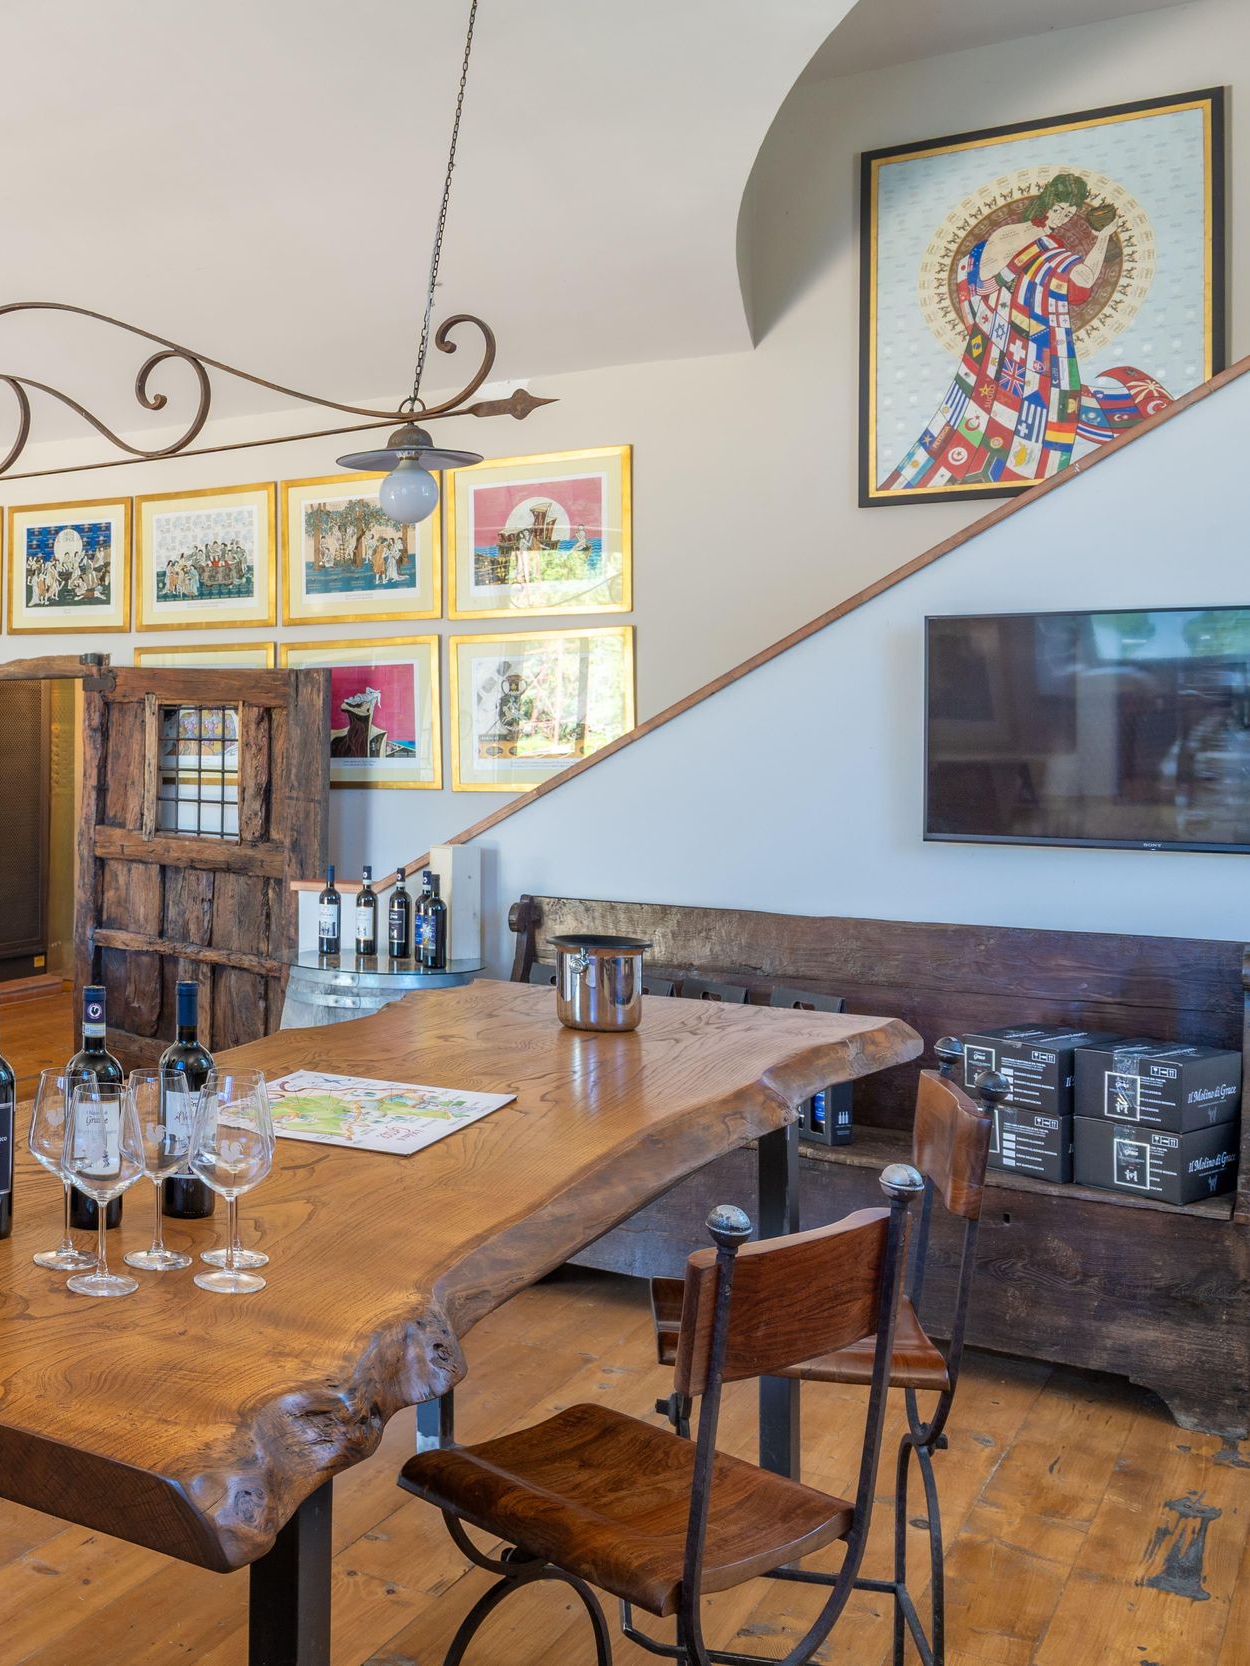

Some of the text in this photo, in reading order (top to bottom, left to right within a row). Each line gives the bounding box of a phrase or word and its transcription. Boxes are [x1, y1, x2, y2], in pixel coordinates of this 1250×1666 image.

[1194, 1088, 1214, 1100] Molino
[1214, 1086, 1220, 1096] di
[1220, 1084, 1236, 1098] Grace
[1194, 1158, 1214, 1171] Molino
[1214, 1156, 1220, 1165] di
